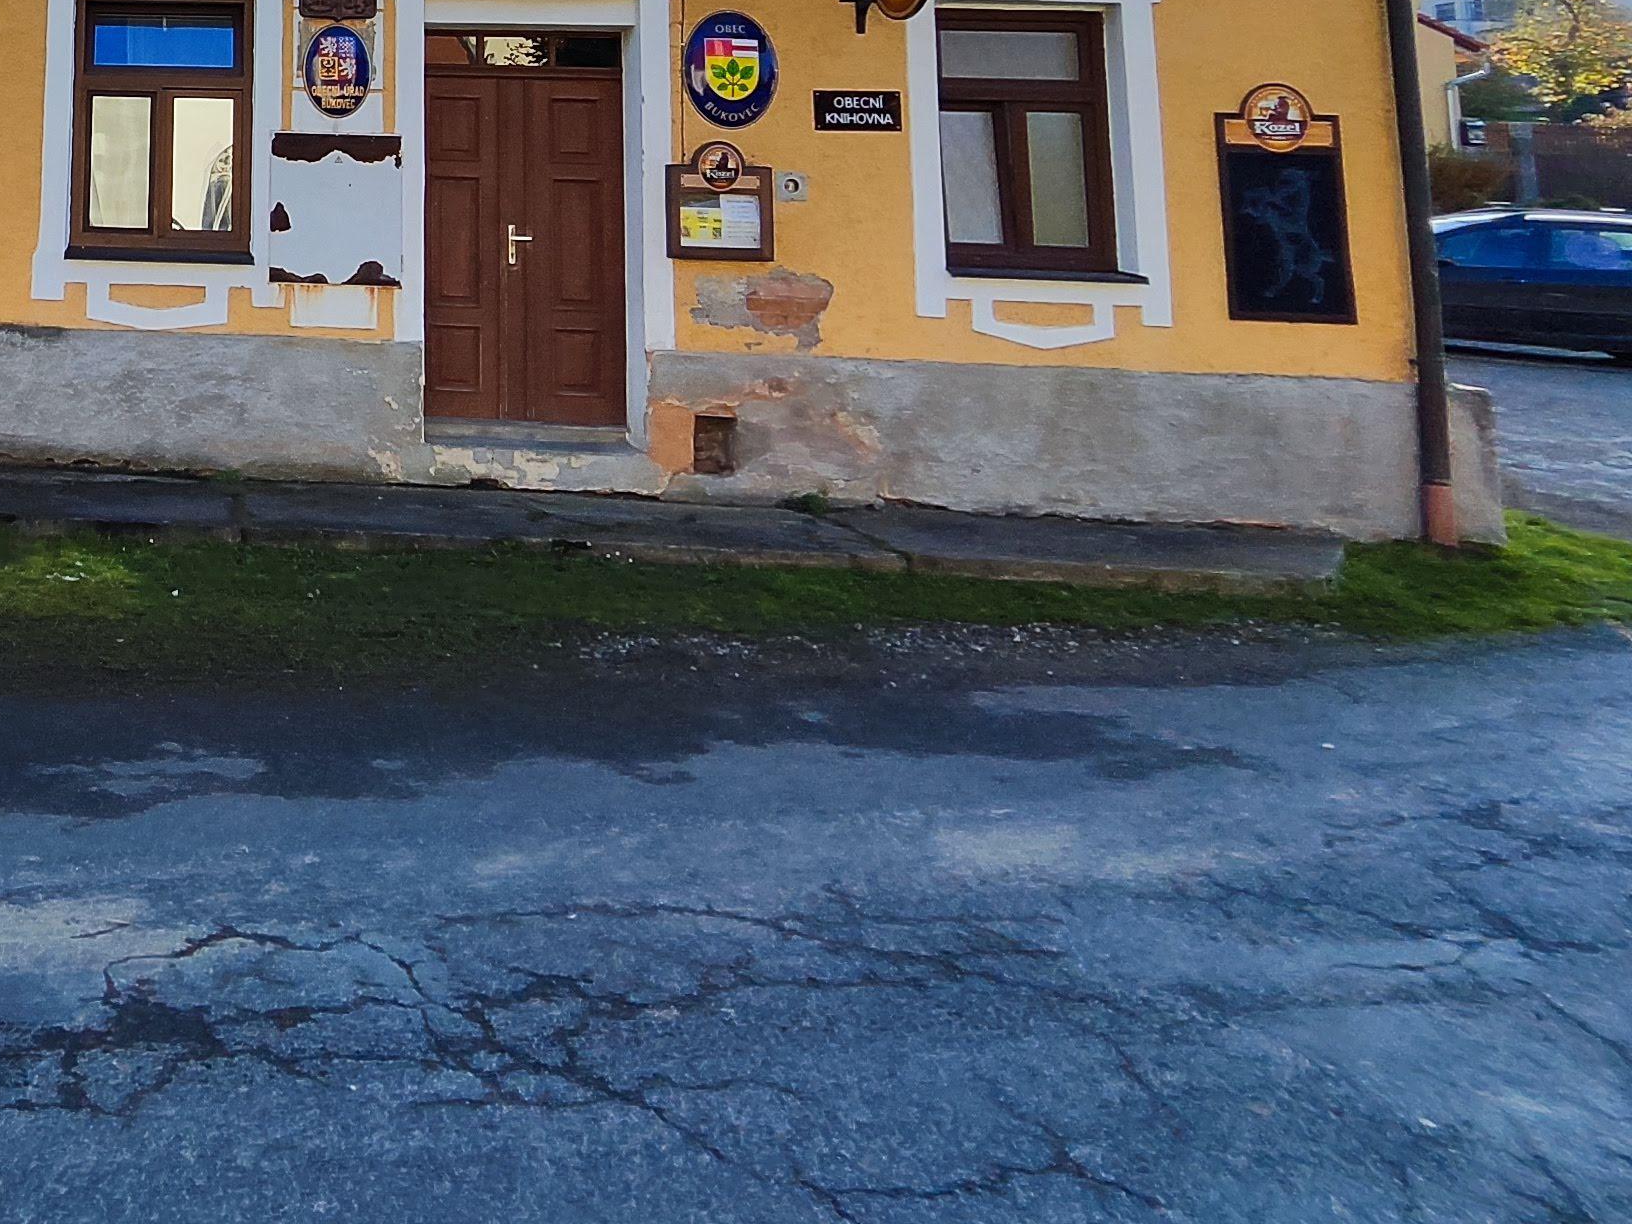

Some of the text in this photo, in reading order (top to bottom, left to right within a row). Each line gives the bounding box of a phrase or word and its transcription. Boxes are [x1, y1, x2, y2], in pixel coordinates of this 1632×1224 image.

[714, 24, 746, 34] OBEC
[833, 95, 884, 109] OBECNÍ
[704, 102, 760, 122] BUKOVEC
[825, 112, 894, 125] KNIHOVNA
[1254, 121, 1301, 135] Kozel
